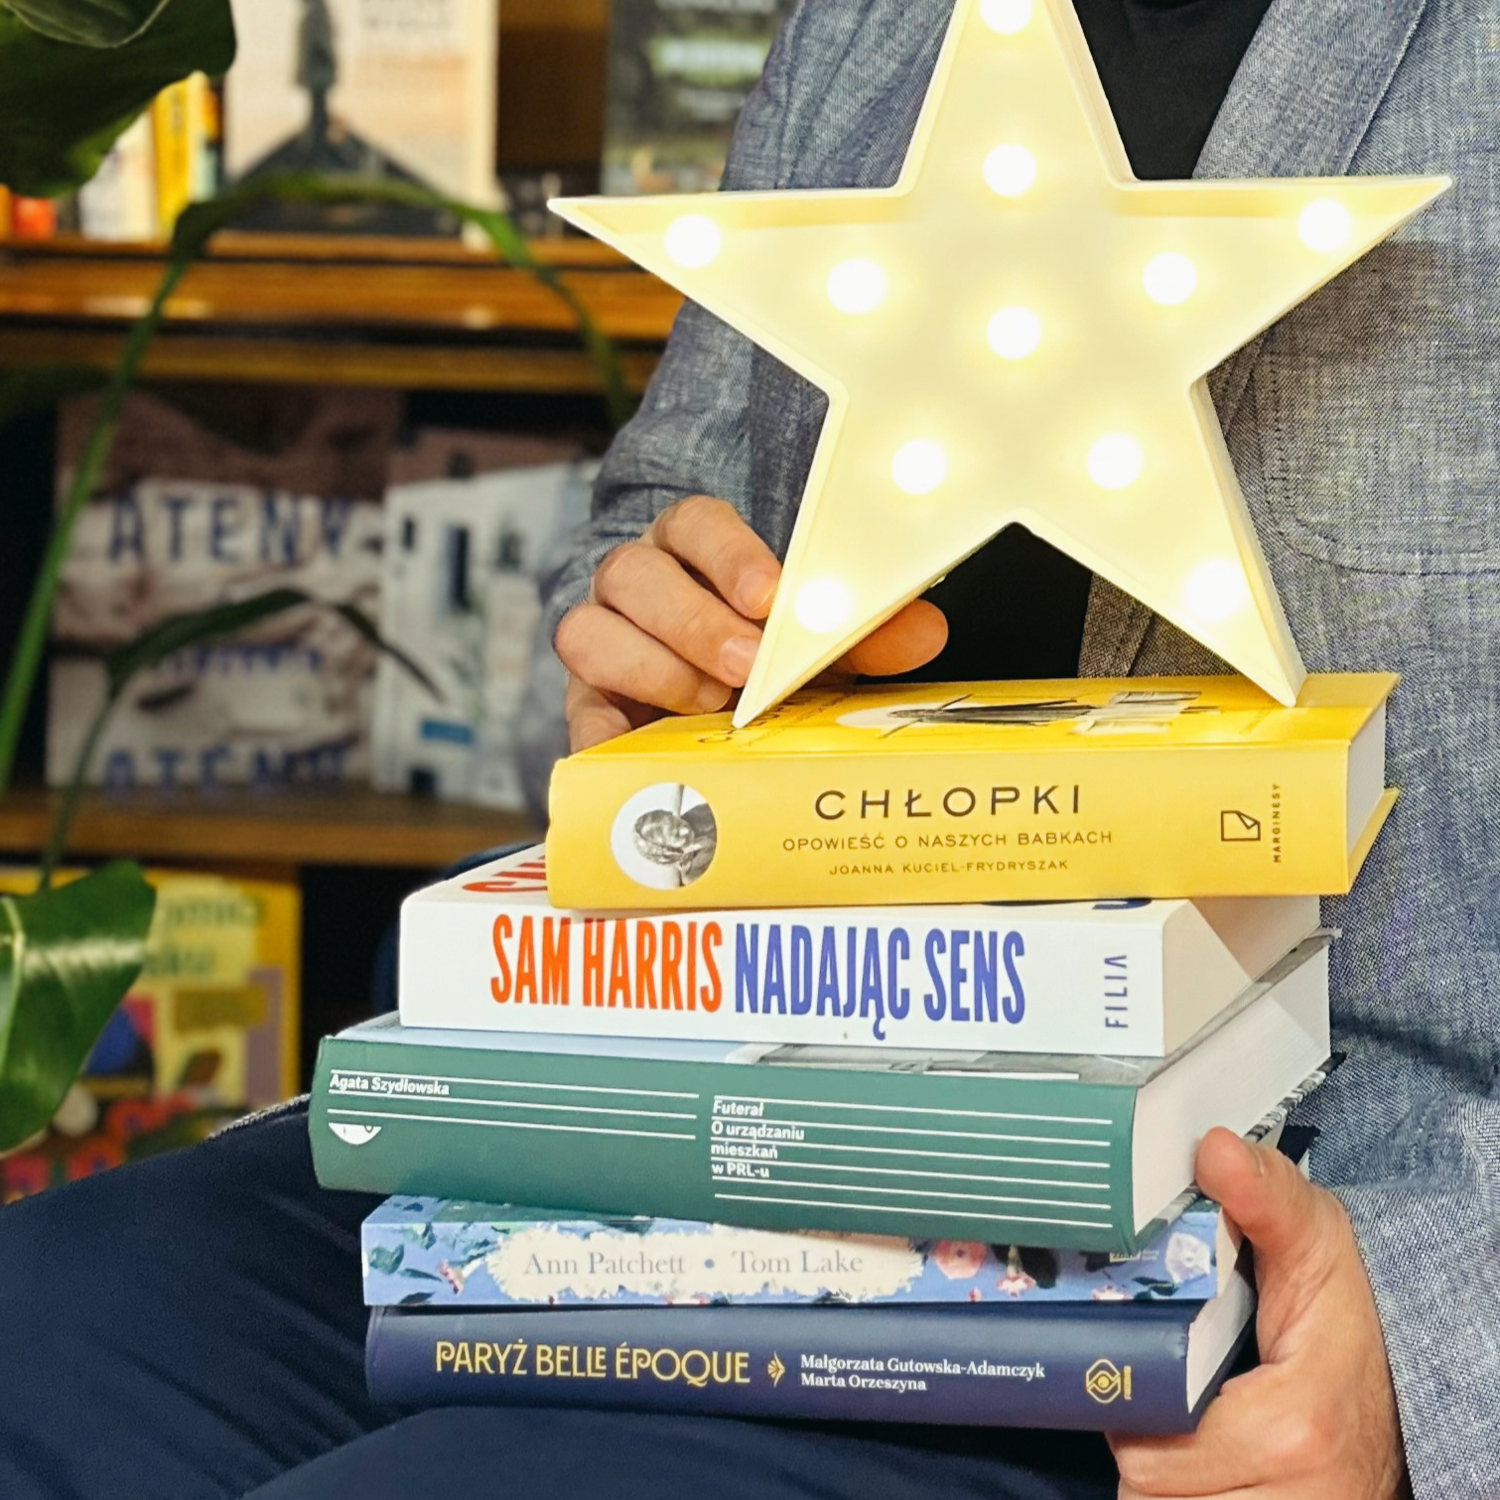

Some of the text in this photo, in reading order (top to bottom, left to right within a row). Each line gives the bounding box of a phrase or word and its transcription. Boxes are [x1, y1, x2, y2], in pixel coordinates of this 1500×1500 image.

[107, 495, 353, 565] ATENY
[814, 784, 1080, 821] CHŁOPKI
[1271, 783, 1282, 864] MARGINESY
[782, 830, 1113, 852] OPOWIEŚĆ O NASZYCH BABKACH
[829, 859, 1069, 876] JOANNA KUCIEL-FRYDRYSZAK
[490, 914, 1025, 1041] SAM HARRIS NADAJĄC SENS
[1104, 954, 1129, 1029] FILIA
[329, 1073, 450, 1096] Agata Szydłowska
[713, 1100, 765, 1117] Futerał
[711, 1120, 805, 1141] O urządzaniu
[711, 1141, 779, 1159] mieszkań
[711, 1162, 770, 1178] w PRL-u
[523, 1249, 863, 1276] Ann Patchett Tom Lake
[436, 1337, 751, 1388] PARYŻ BELLE ÉPOQUE
[800, 1354, 1045, 1381] Małgorzata Gutowska-Adamczyk
[800, 1372, 928, 1393] Marta Orzeszyna
